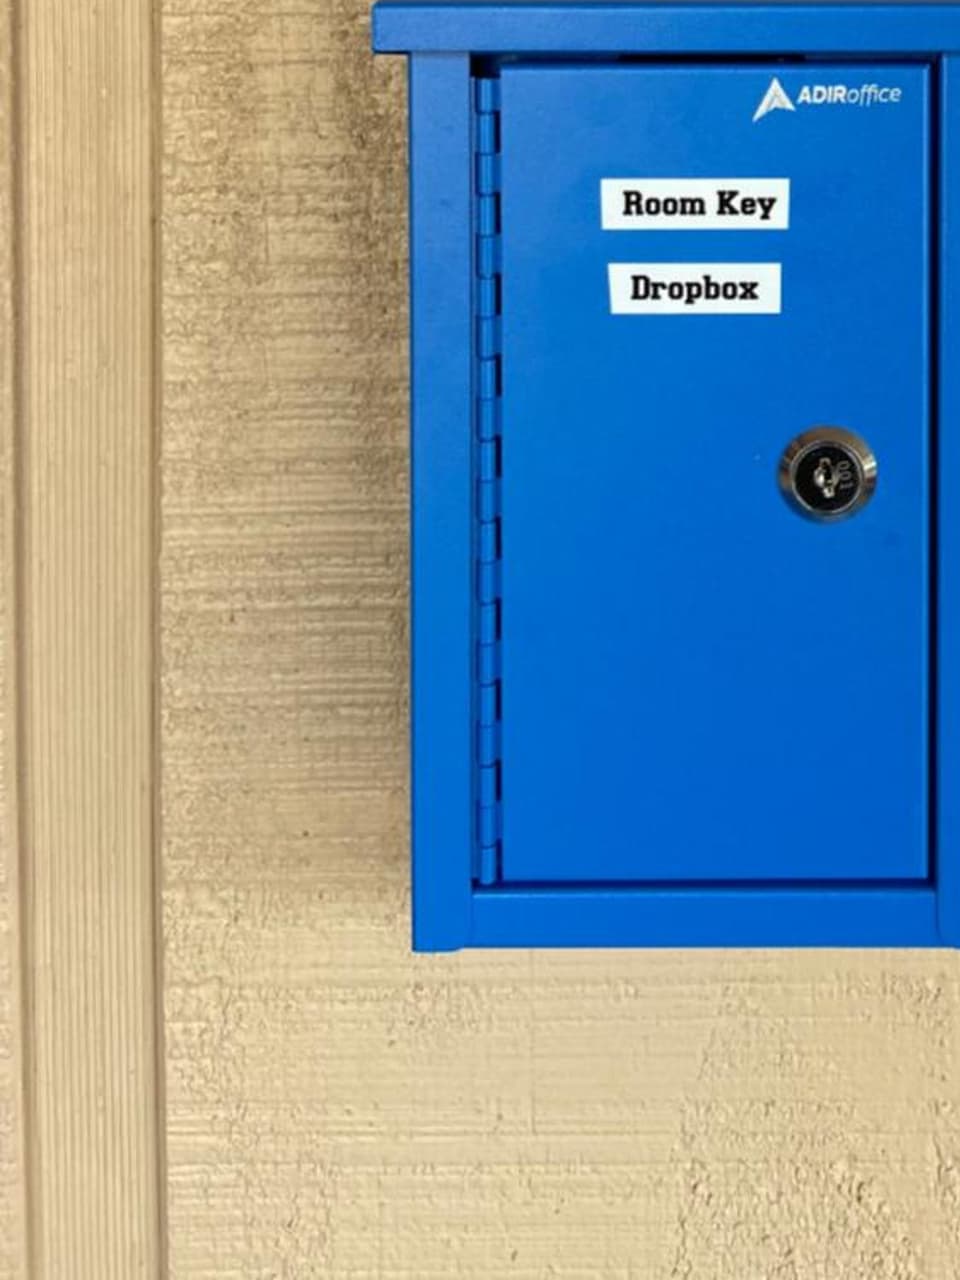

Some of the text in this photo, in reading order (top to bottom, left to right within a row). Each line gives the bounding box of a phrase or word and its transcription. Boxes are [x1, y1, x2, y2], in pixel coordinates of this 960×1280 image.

[796, 84, 902, 107] ADIRoffice
[622, 190, 777, 220] Room Key
[631, 274, 759, 305] Dropbox
